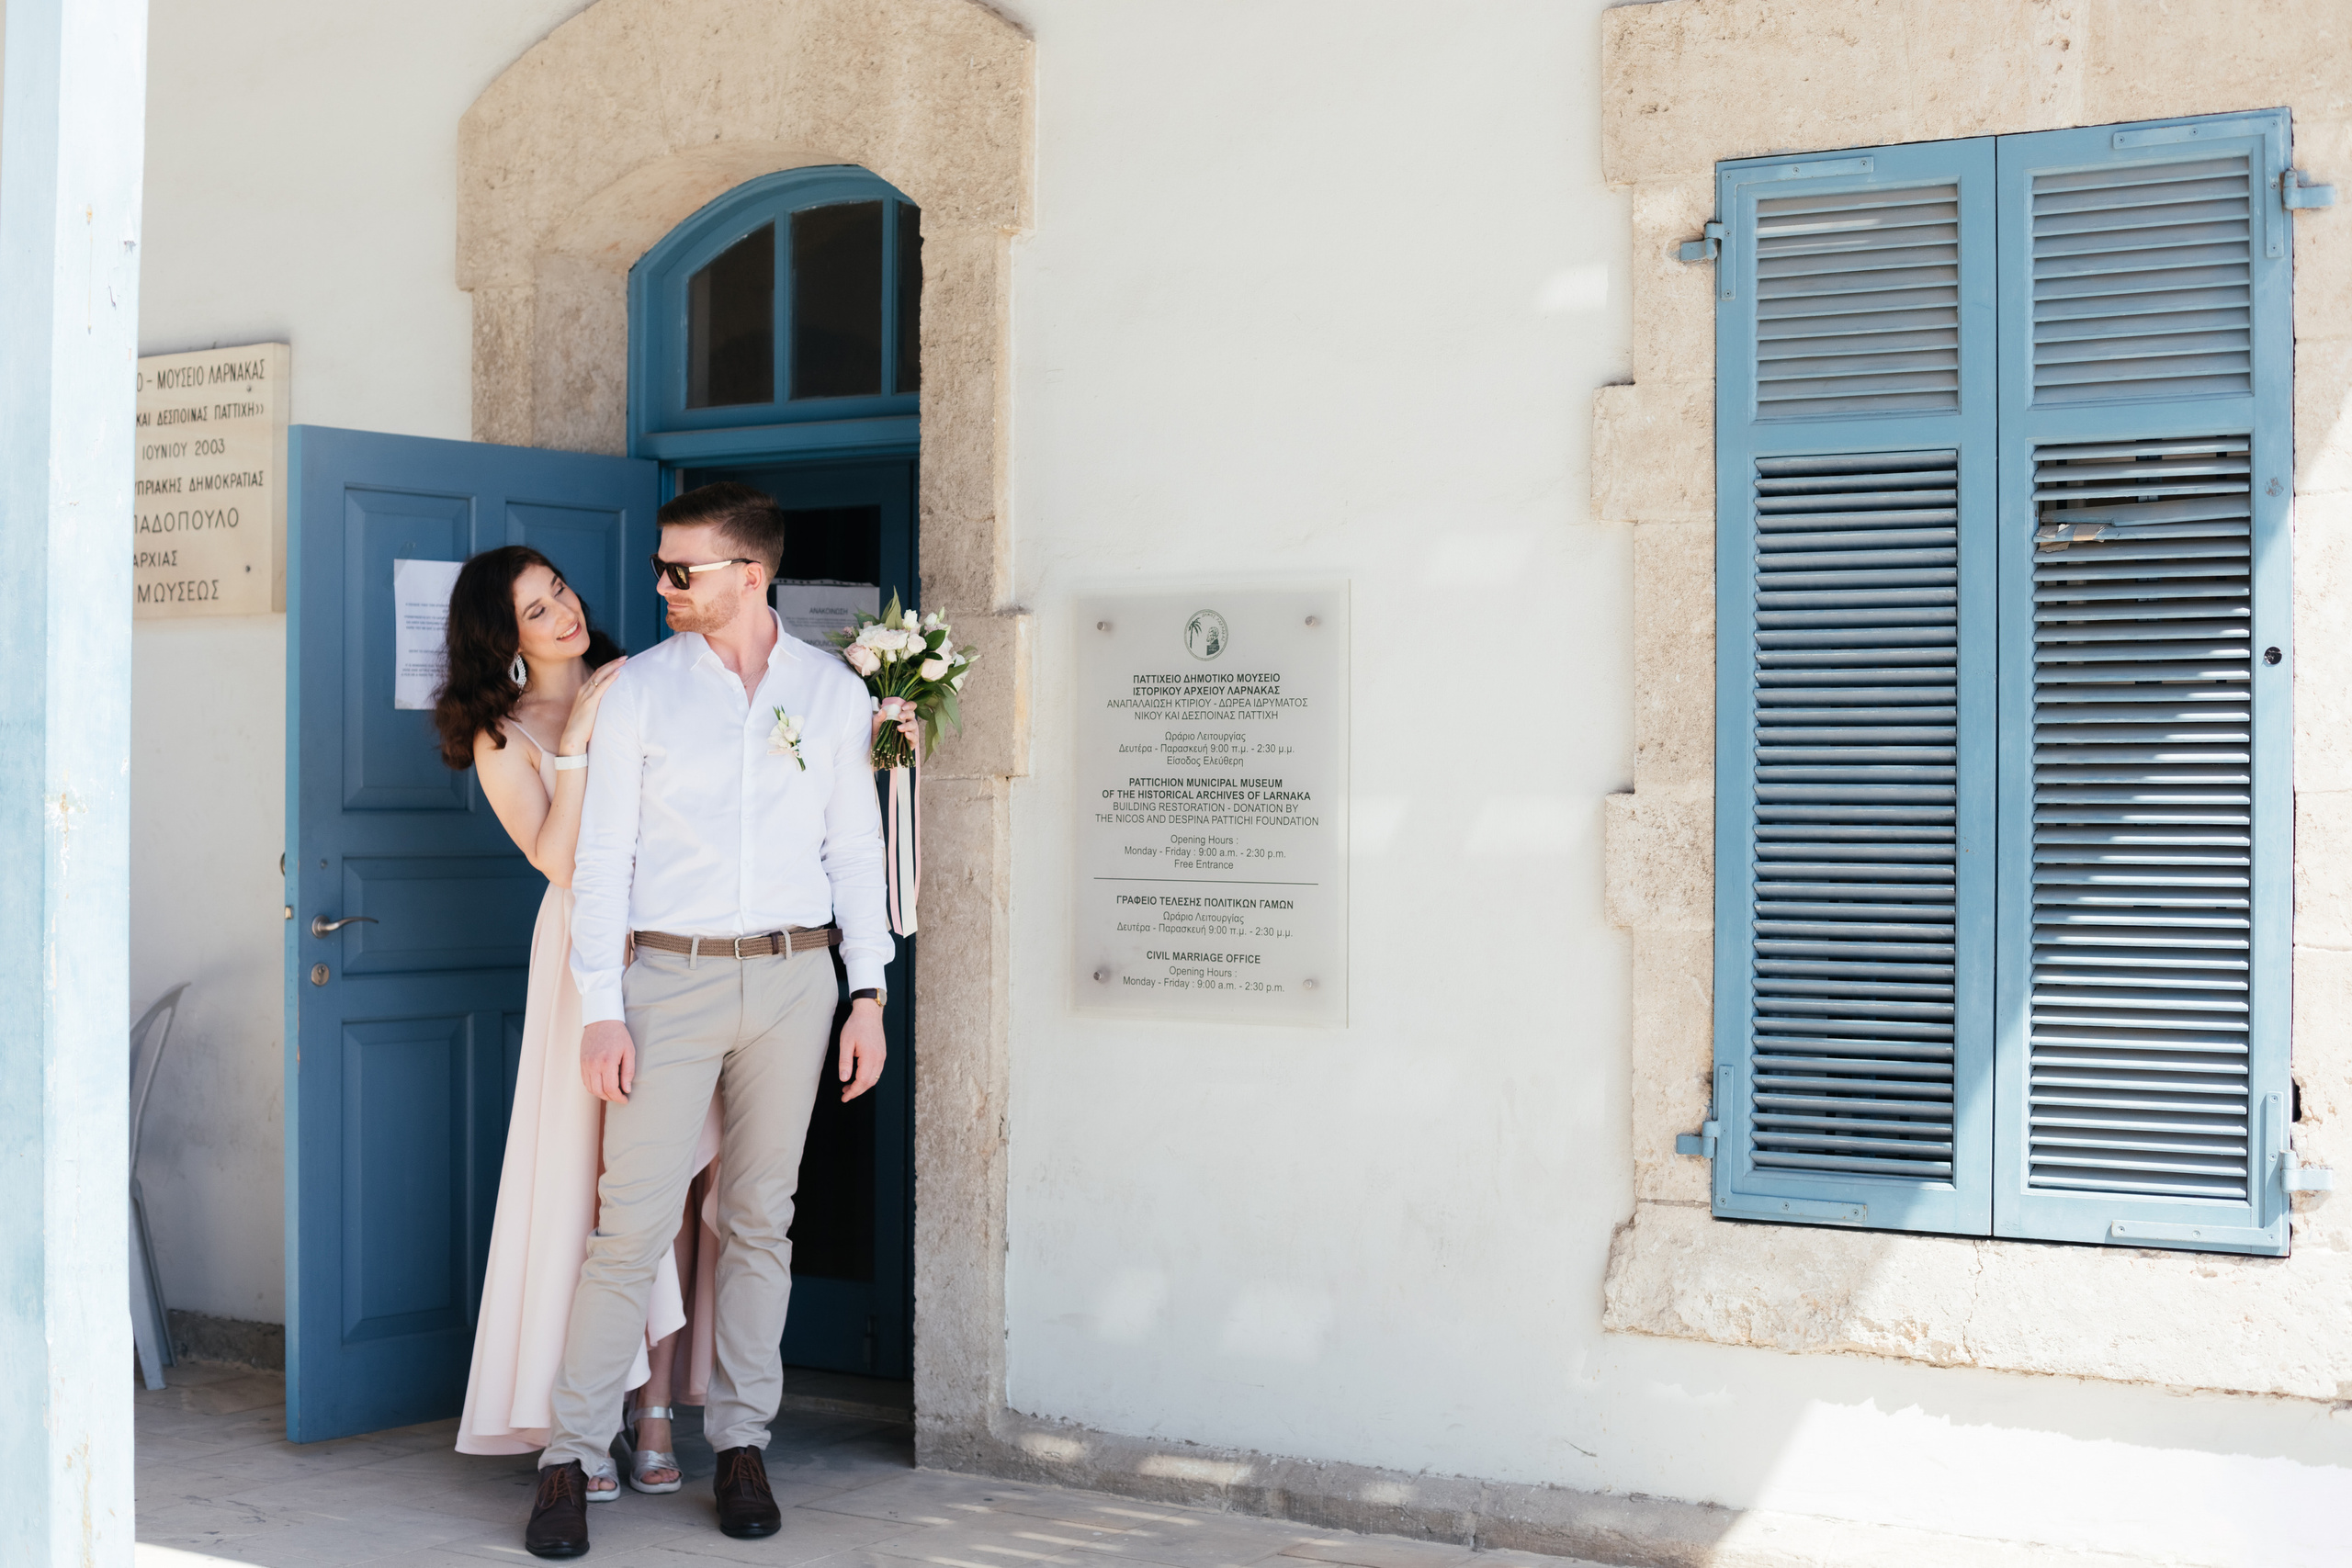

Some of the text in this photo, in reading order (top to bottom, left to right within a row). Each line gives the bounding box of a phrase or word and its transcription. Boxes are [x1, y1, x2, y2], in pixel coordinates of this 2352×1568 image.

[157, 366, 204, 389] ΜΟΥΣΕΙΟ
[209, 359, 265, 385] ΛΑΡΝΑΚΑΣ
[157, 406, 208, 426] ΔΕΣΠΟΙΝΑΣ
[142, 439, 225, 460] ΙΟΥΝΙΟΥ 2003
[189, 470, 264, 492] ΔΗΜΟΚΡΑΤΙΑΣ
[138, 580, 220, 604] ΜΩΥΣΕΩΣ
[1133, 672, 1281, 684] ΠΑΤΤΙΧΕΙΟ ΔΗΜΟΤΙΚΟ ΜΟΥΣΕΙΟ
[1133, 684, 1281, 696] ΙΣΤΟΡΙΚΟΥ ΑΡΧΕΙΟΥ ΛΑΡΝΑΚΑΣ
[1106, 697, 1172, 709] ΑΝΑΠΑΛΑΙΩΣΗ
[1174, 697, 1212, 709] ΚΤΙΡΙΟΥ
[1218, 697, 1251, 708] ΔΩΡΕΑ
[1254, 697, 1308, 708] ΙΔΡΥΜΑΤΟΣ
[1135, 709, 1279, 721] ΝΙΚΟΥ ΚΑΙ ΔΕΣΠΟΙΝΑΣ ΠΑΤΤΙΧΗ
[1164, 730, 1246, 744] Ωράριο Λειτουργίας
[1118, 742, 1153, 755] Δευτέρα
[1160, 742, 1208, 756] Παρασκευή
[1210, 743, 1230, 754] 9:00
[1231, 745, 1249, 756] π.μ.
[1257, 743, 1276, 754] 2:30
[1278, 745, 1295, 756] μ.μ.
[1167, 755, 1244, 768] Είσοδος Ελεύθερη
[1128, 777, 1283, 788] PATTICHION MUNICIPAL MUSEUM
[1102, 789, 1311, 801] OF THE HISTORICAL ARCHIVES OF LARNAKA
[1113, 802, 1157, 812] BUILDING
[1159, 802, 1226, 813] RESTORATION
[1233, 803, 1284, 813] DONATION
[1285, 803, 1299, 814] BY
[1095, 813, 1319, 827] THE NICOS AND DESPINA PATTICHI FOUNDATION
[1170, 834, 1206, 847] Opening
[1208, 834, 1235, 845] Hours
[1124, 846, 1158, 858] Monday
[1165, 846, 1192, 858] Friday
[1198, 847, 1217, 858] 9:00
[1219, 849, 1238, 858] a.m.
[1246, 848, 1265, 859] 2:30
[1267, 850, 1286, 861] p.m.
[1174, 859, 1234, 870] Free Entrance
[1116, 895, 1294, 910] ΓΡΑΦΕΙΟ ΤΕΛΕΣΗΣ ΠΟΛΙΤΙΚΩΝ ΓΑΜΩΝ
[1162, 911, 1245, 926] Ωράριο Λειτουργίας
[1116, 921, 1151, 934] Δευτέρα
[1159, 922, 1206, 936] Παρασκευή
[1208, 924, 1227, 936] 9:00
[1229, 927, 1248, 937] π.μ.
[1255, 926, 1274, 937] 2:30
[1276, 928, 1294, 939] μ.μ.
[1146, 950, 1261, 964] CIVIL MARRIAGE OFFICE
[1169, 965, 1204, 978] Opening
[1206, 966, 1233, 977] Hours
[1123, 976, 1156, 988] Monday
[1163, 977, 1190, 989] Friday
[1196, 978, 1216, 989] 9:00
[1217, 981, 1237, 990] a.m.
[1244, 980, 1264, 992] 2:30
[1265, 984, 1285, 994] p.m.
